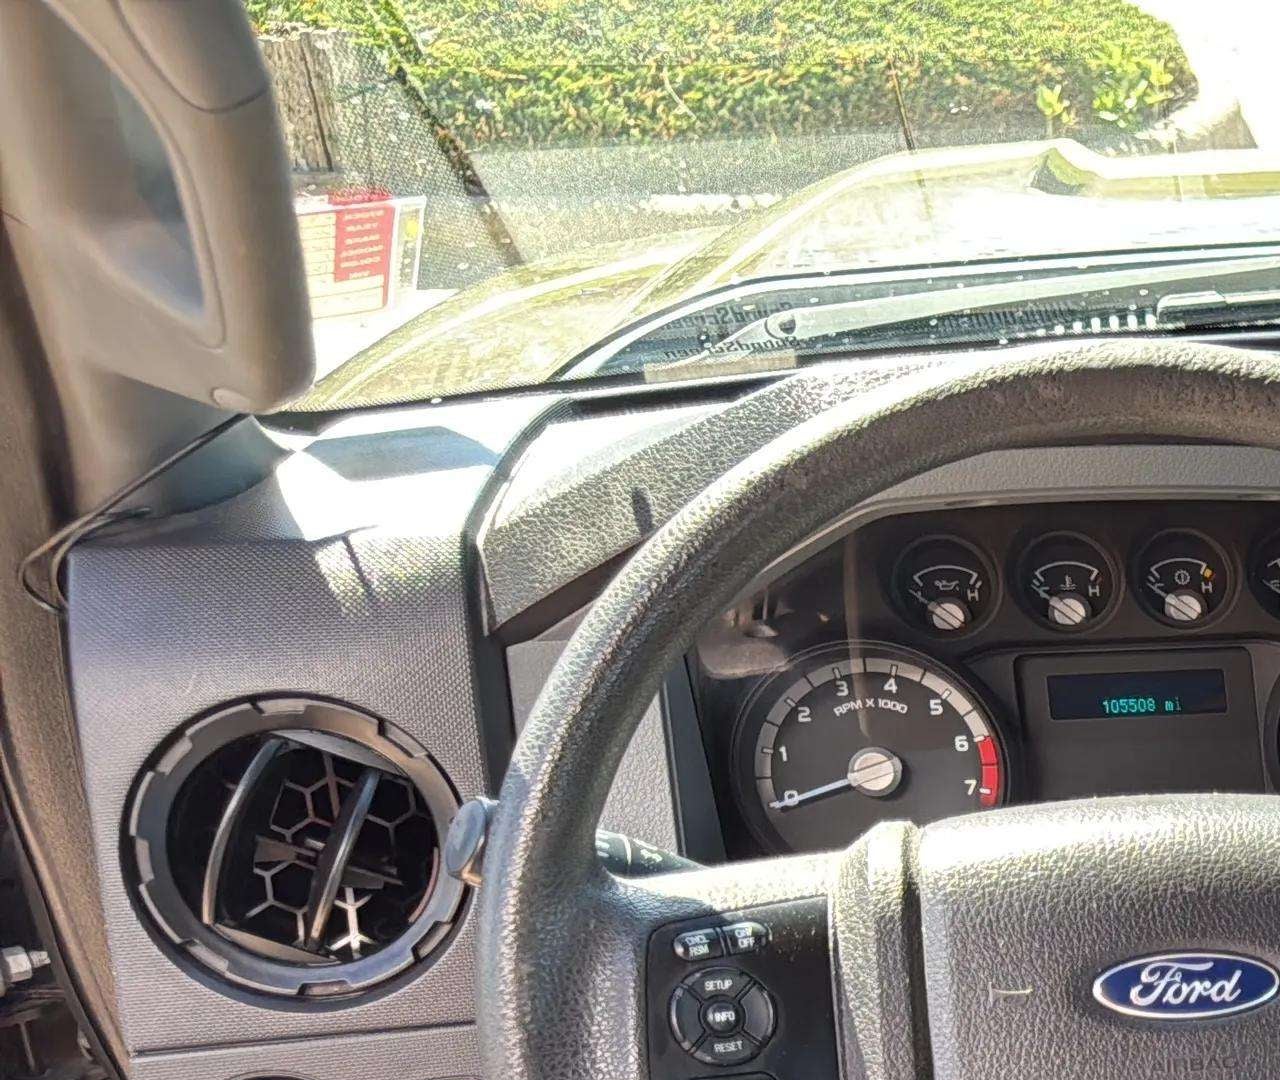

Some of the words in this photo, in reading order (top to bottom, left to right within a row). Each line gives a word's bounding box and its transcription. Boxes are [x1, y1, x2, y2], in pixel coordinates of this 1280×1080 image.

[968, 589, 979, 601] H
[1089, 585, 1100, 597] H
[1201, 582, 1213, 594] H
[836, 681, 849, 696] 3
[884, 678, 898, 693] 4
[833, 700, 863, 717] RPM
[866, 699, 875, 708] X
[878, 698, 908, 714] 1000
[929, 700, 944, 716] 5
[1102, 698, 1156, 714] 105508
[1165, 697, 1182, 711] mi
[798, 707, 812, 722] 2
[954, 735, 969, 752] 6
[779, 746, 788, 762] 1
[964, 779, 977, 795] 7
[704, 980, 733, 991] SETUP
[1130, 961, 1243, 1006] Ford
[714, 1010, 735, 1022] INFO
[714, 1040, 743, 1053] RESET
